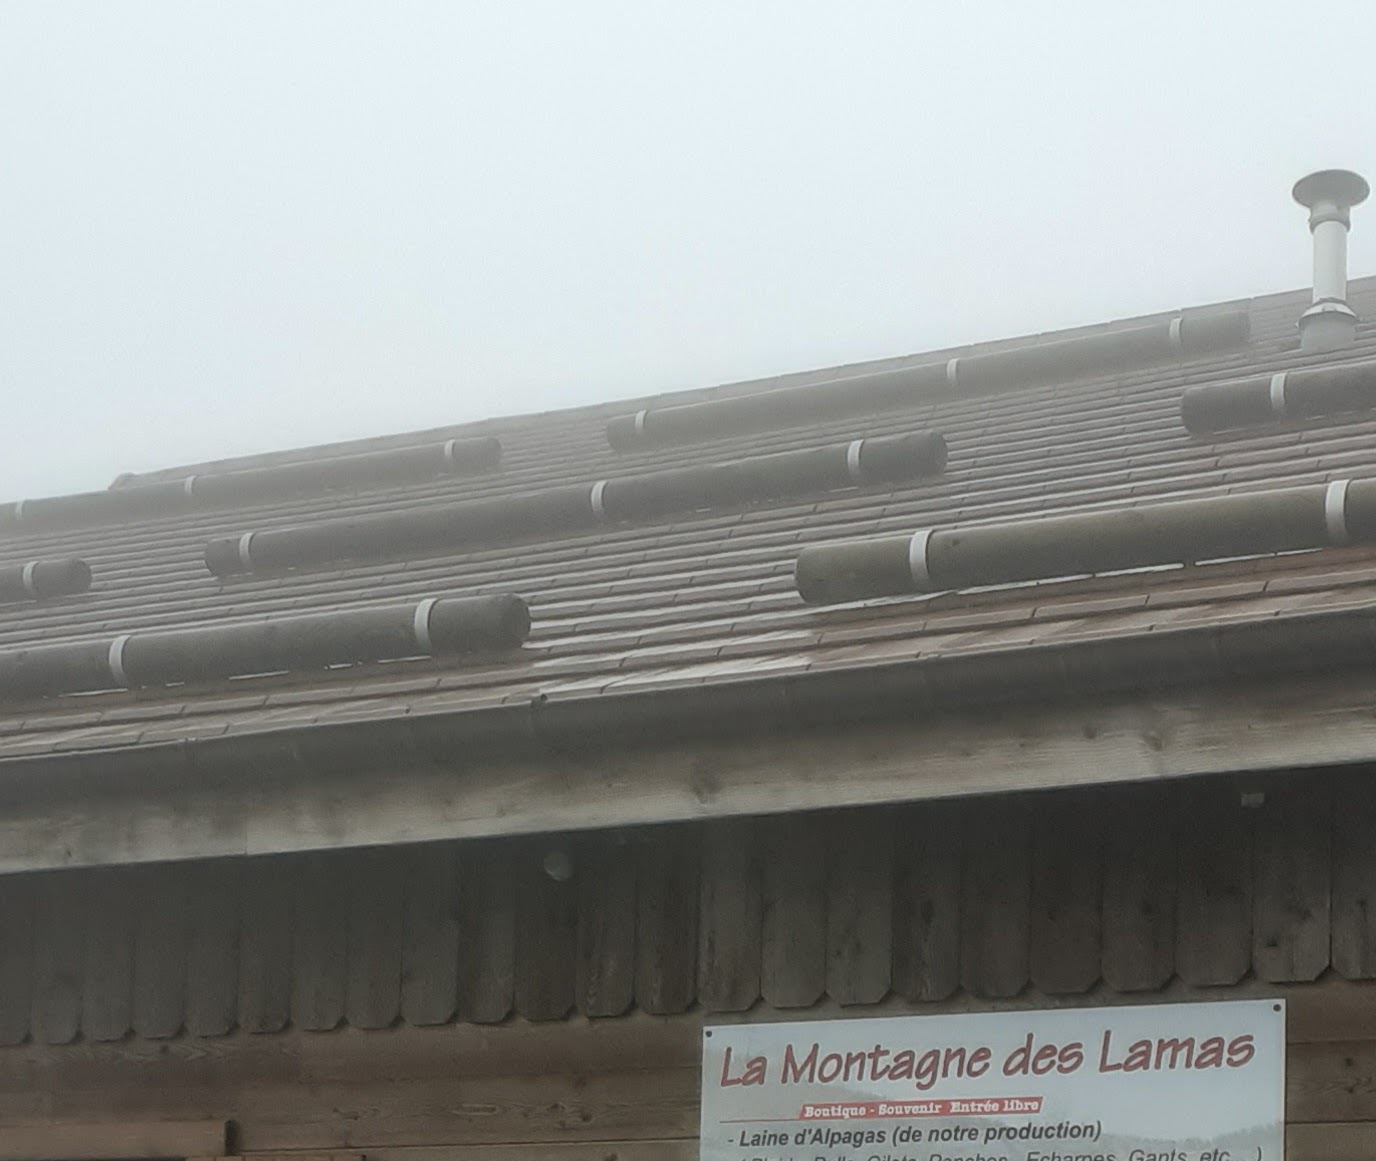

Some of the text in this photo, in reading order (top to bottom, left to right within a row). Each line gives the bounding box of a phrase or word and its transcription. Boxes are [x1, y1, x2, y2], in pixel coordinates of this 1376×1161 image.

[721, 1030, 1256, 1090] La Montagne des Lamas
[804, 1105, 866, 1119] Boutique
[878, 1103, 942, 1115] Souvenir
[950, 1100, 999, 1113] Entrée
[1003, 1099, 1039, 1111] libre
[739, 1130, 789, 1147] Laine
[794, 1128, 886, 1148] d'Alpagas
[892, 1126, 922, 1147] (de
[928, 1127, 978, 1142] notre
[984, 1120, 1101, 1144] production)
